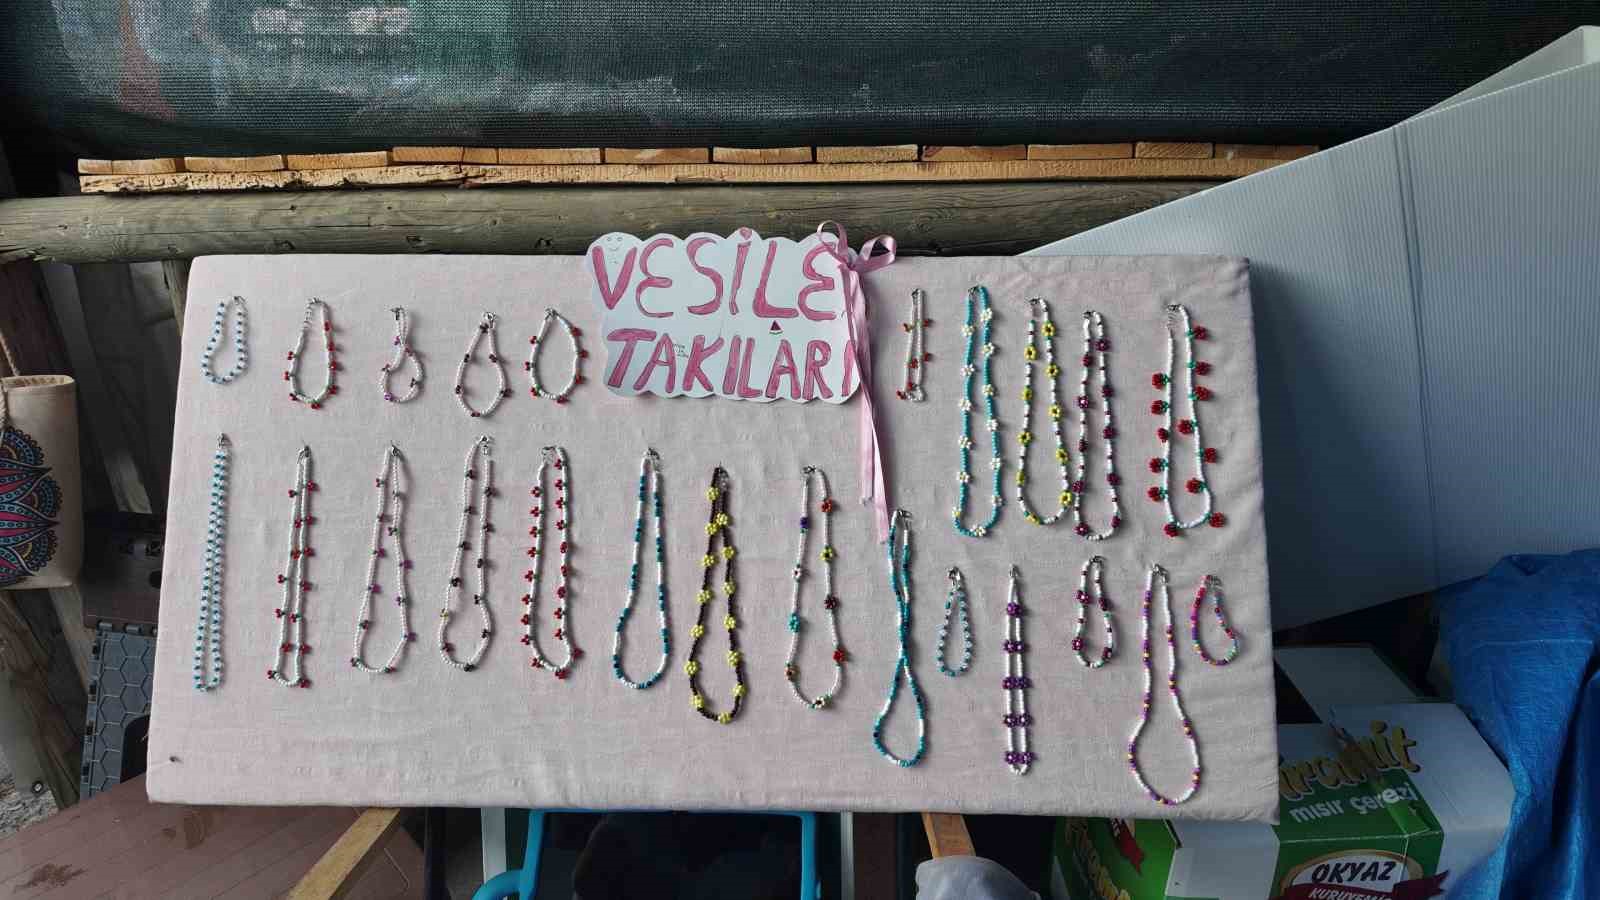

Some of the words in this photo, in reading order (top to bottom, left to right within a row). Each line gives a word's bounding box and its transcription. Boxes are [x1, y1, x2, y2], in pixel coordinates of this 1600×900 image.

[591, 227, 838, 320] VESİLE
[606, 327, 855, 401] TAKILARI
[1311, 860, 1397, 883] OKYAZ
